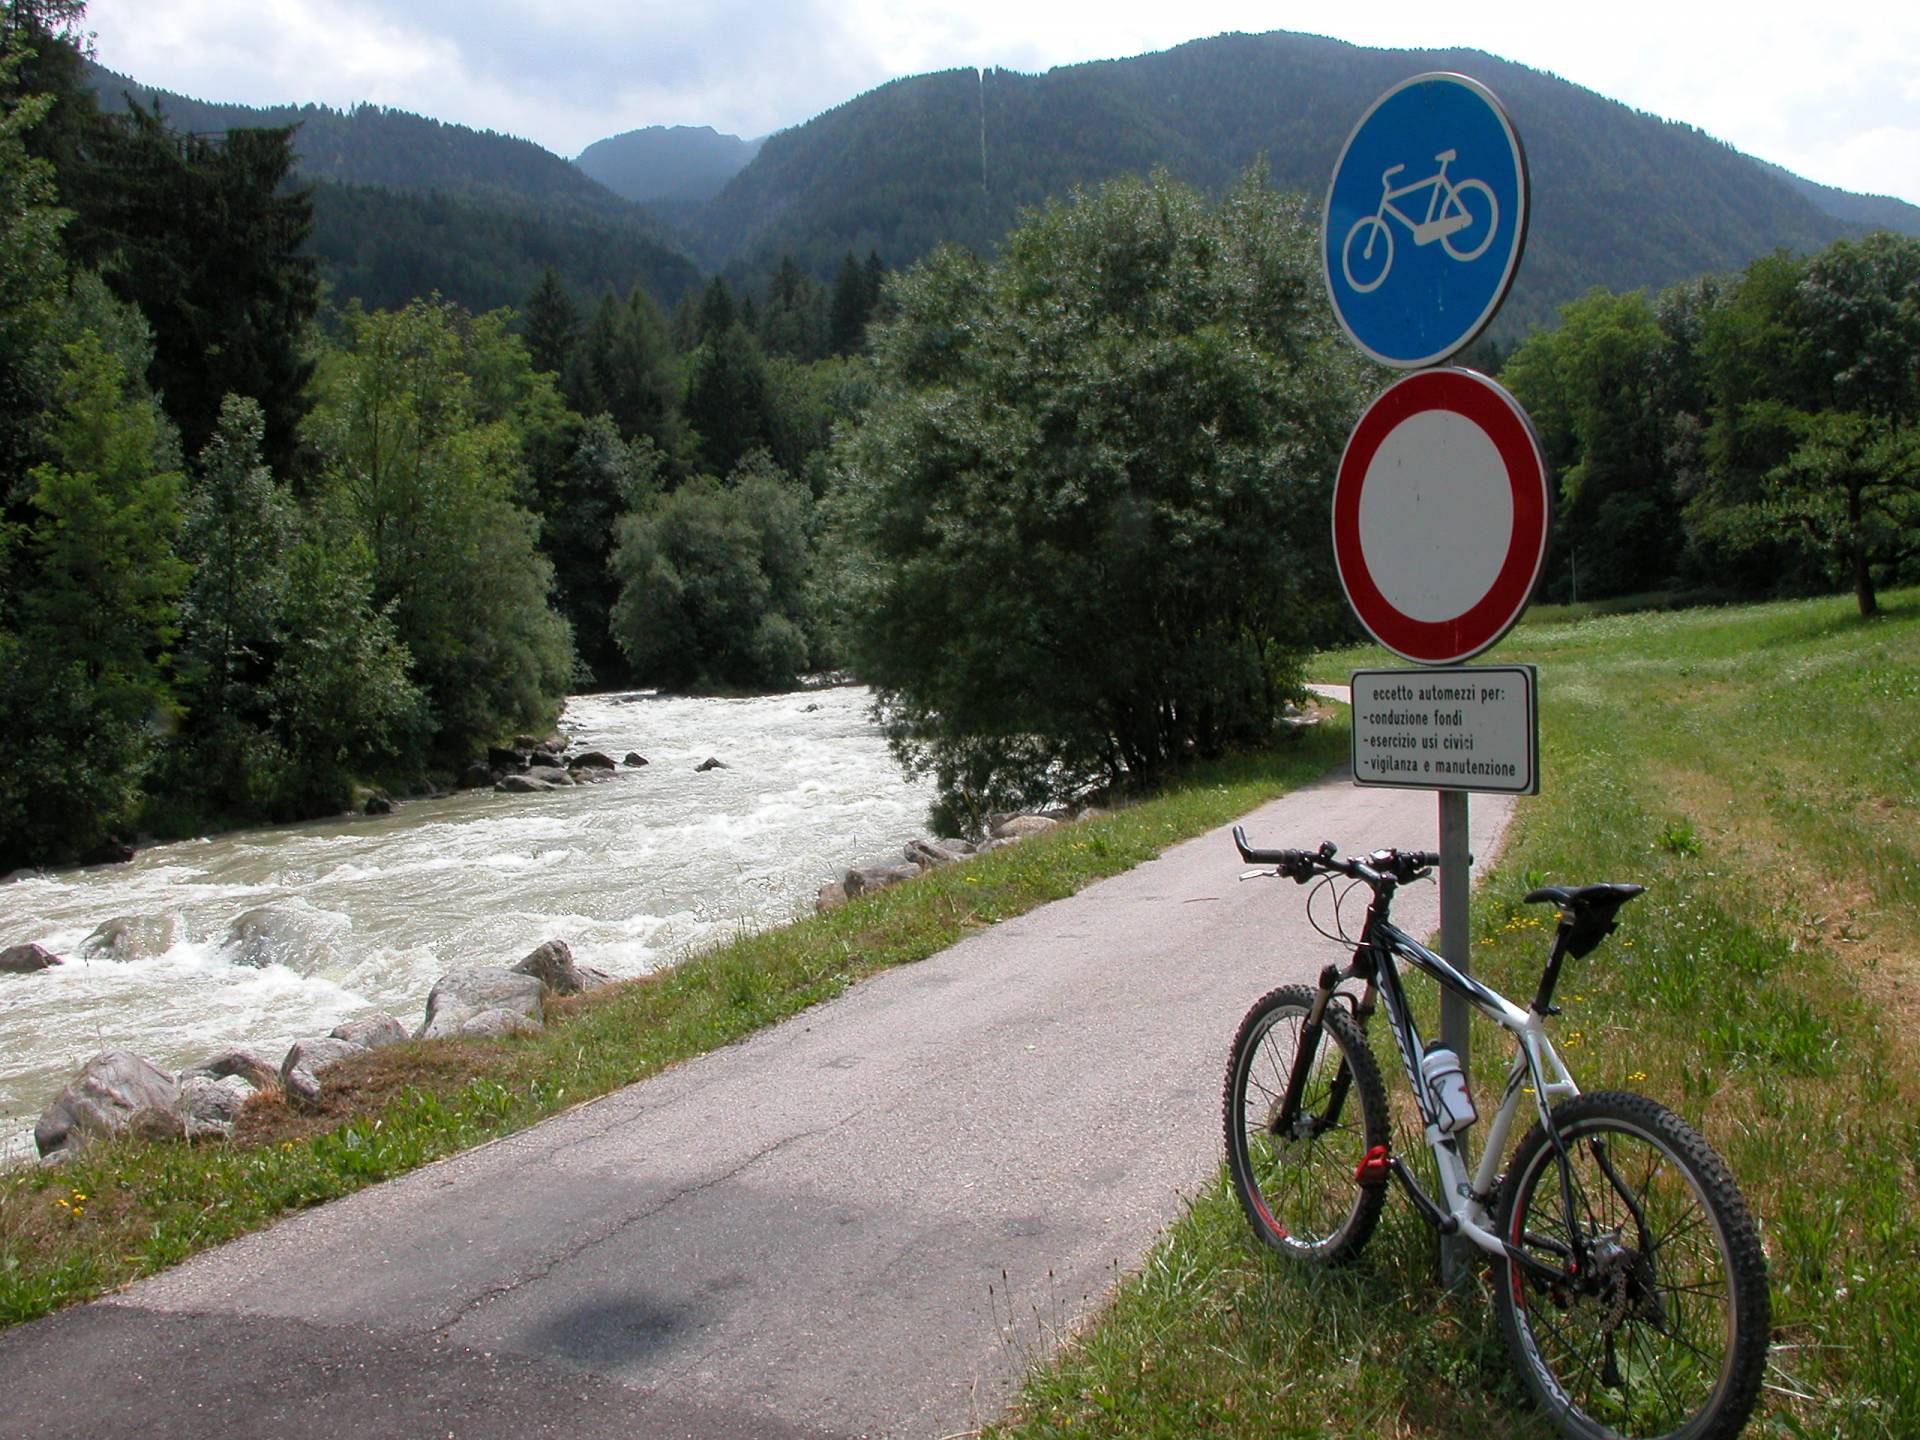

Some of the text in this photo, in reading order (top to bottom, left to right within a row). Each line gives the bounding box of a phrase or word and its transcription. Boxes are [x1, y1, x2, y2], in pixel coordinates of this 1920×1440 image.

[1373, 685, 1505, 704] eccetto automezzi per:
[1435, 710, 1462, 726] fondi
[1422, 735, 1437, 749] usi
[1444, 734, 1473, 750] civici
[1424, 763, 1429, 772] e
[1436, 759, 1515, 776] manutenzione
